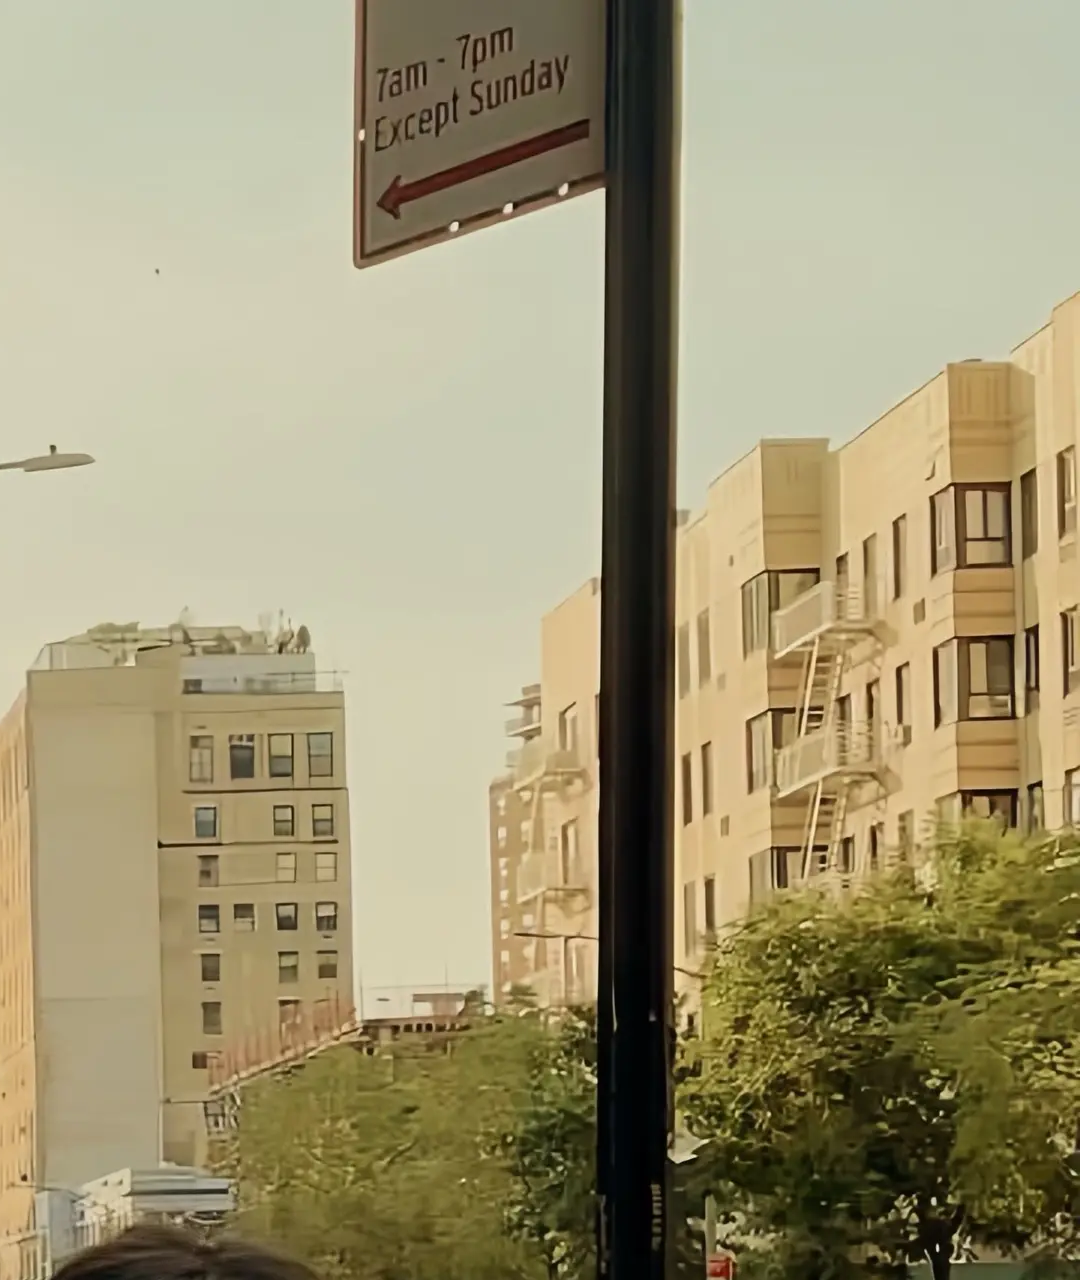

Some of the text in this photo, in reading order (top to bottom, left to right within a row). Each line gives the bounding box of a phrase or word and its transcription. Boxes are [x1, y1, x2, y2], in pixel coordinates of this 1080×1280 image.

[374, 54, 570, 152] Except Sunday
[376, 60, 428, 102] 7am
[456, 26, 514, 73] 7pm
